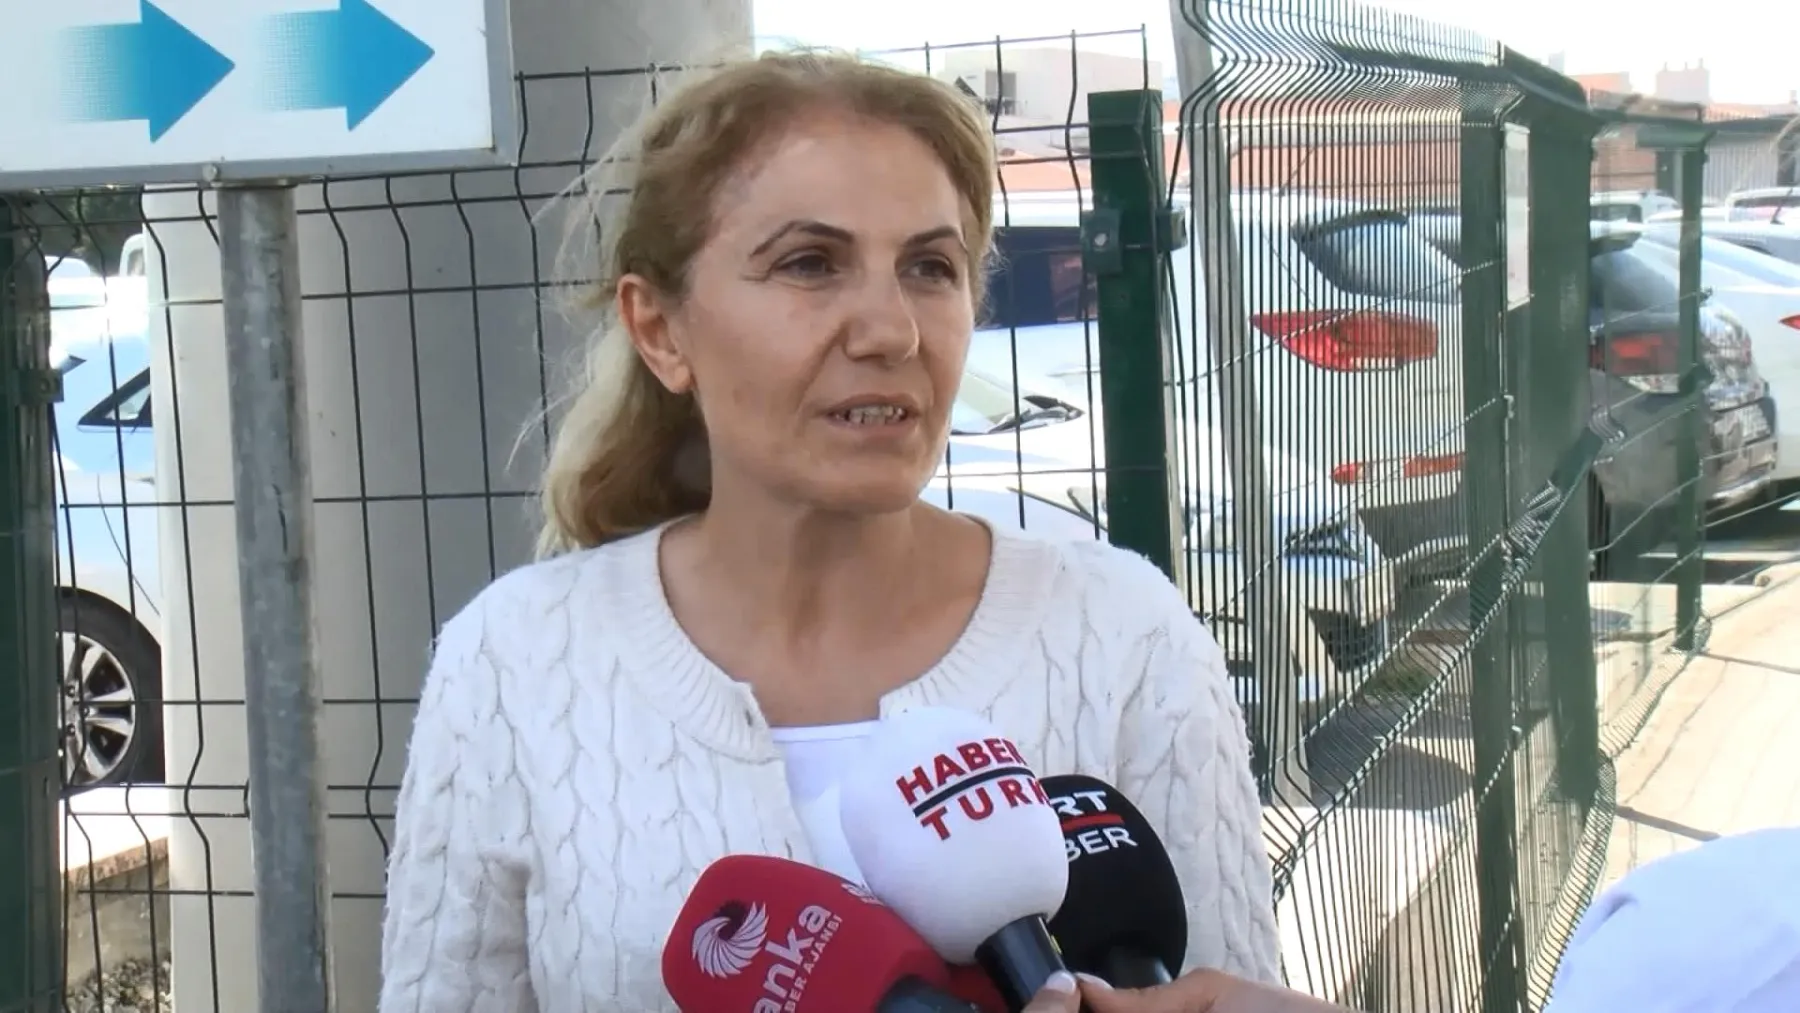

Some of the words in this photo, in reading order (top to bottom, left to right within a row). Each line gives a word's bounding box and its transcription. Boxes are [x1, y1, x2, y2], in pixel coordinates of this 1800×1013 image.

[920, 777, 1051, 841] TURK
[1049, 790, 1107, 816] RT
[1064, 826, 1138, 862] BER
[784, 976, 807, 1013] BER
